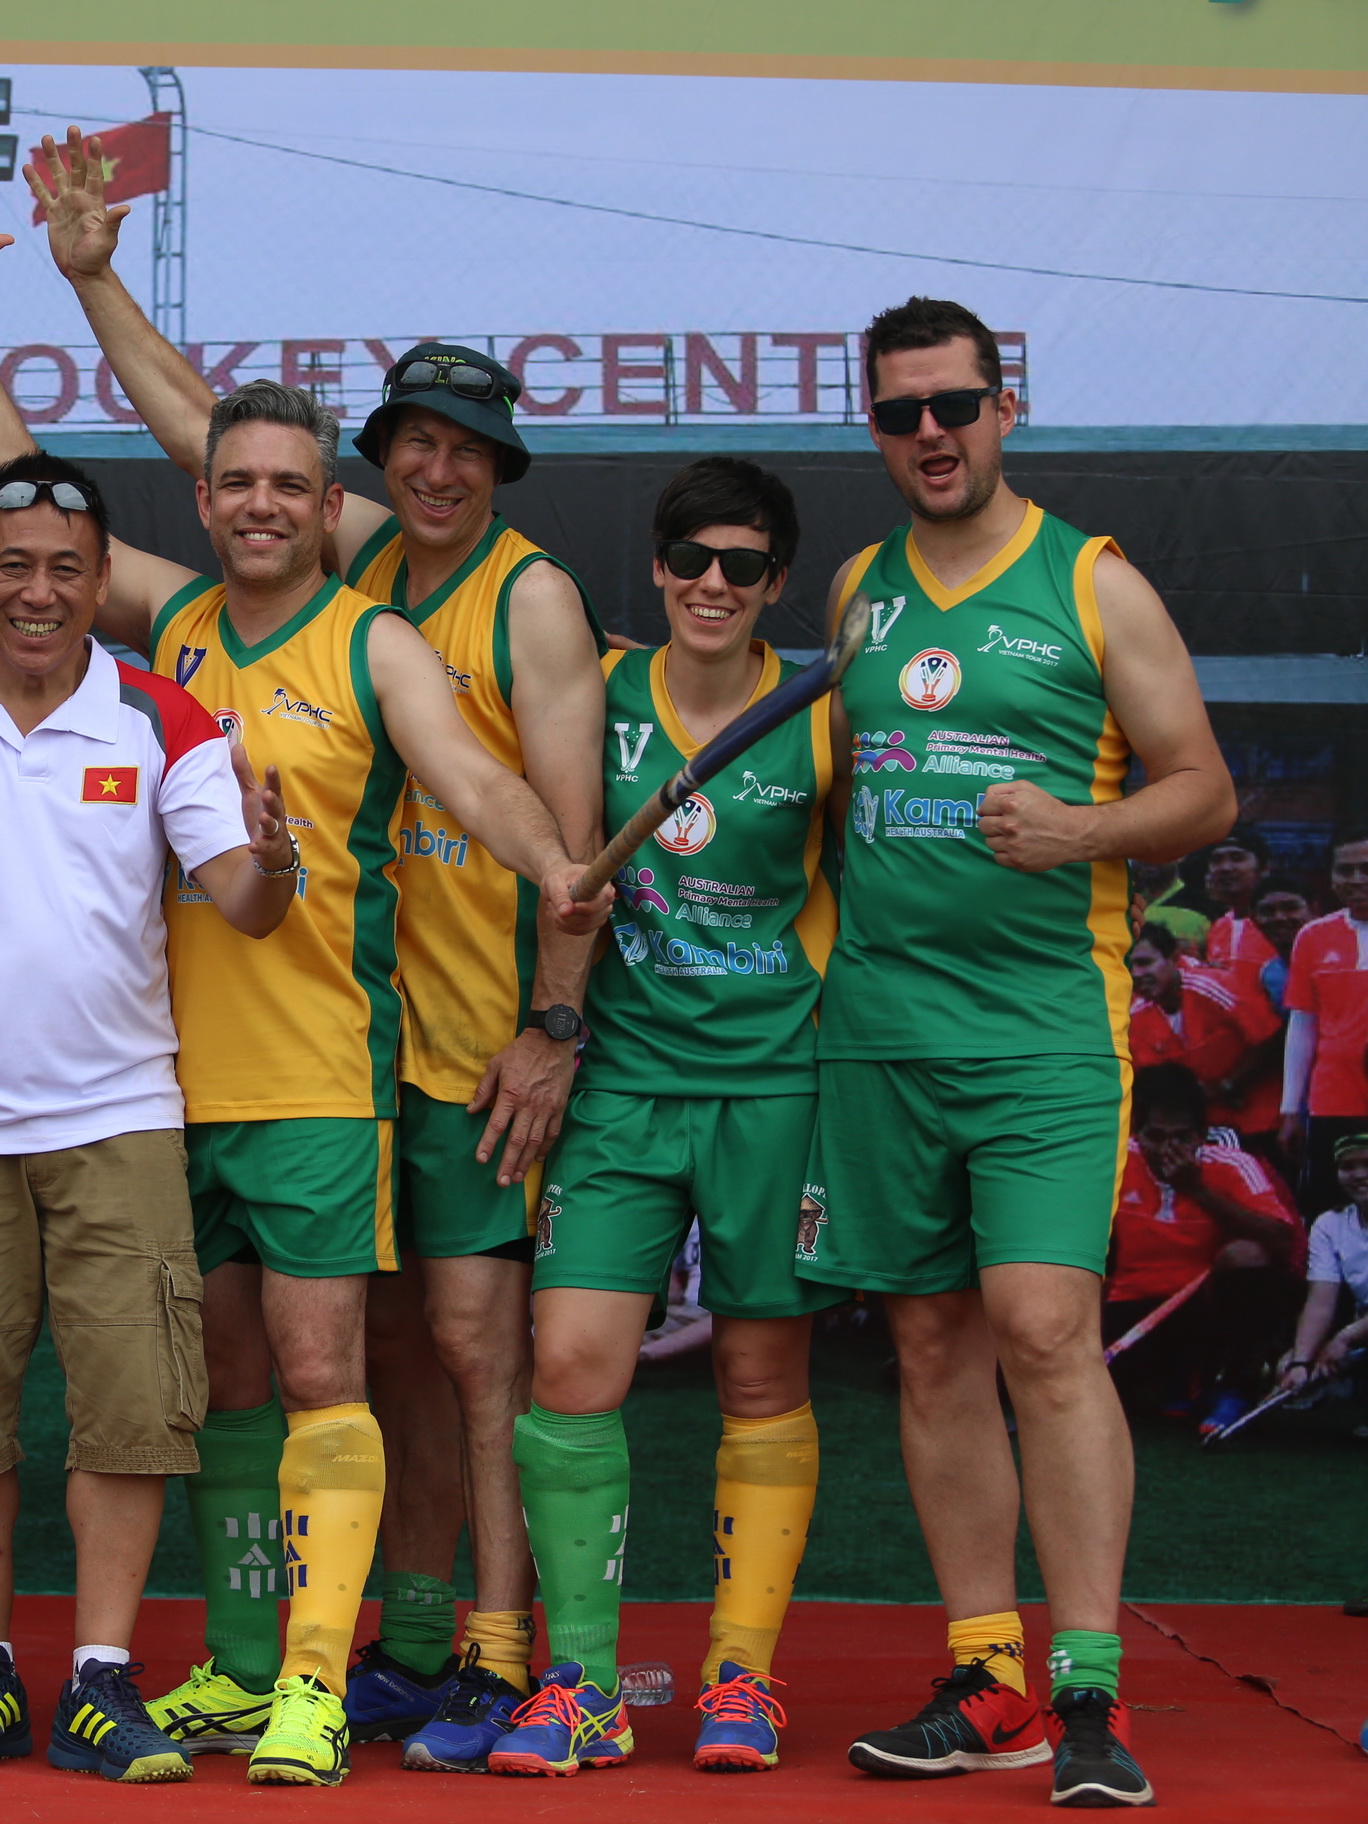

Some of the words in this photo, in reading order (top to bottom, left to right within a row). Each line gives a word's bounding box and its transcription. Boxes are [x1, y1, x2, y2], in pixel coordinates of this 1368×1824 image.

[509, 332, 1026, 416] CENTE
[864, 644, 888, 654] VPHC
[998, 649, 1025, 659] VIETNAM
[1025, 654, 1042, 663] TOUR
[1042, 658, 1059, 667] 2017
[1001, 635, 1063, 660] VPHC
[445, 664, 472, 688] PHC
[284, 699, 334, 723] VPHC
[927, 730, 1010, 746] AUSTRALIAN
[925, 742, 969, 755] Primary
[969, 745, 1009, 757] Mental
[1009, 749, 1047, 763] Health
[921, 754, 1016, 780] Alliance
[615, 774, 639, 783] VPHC
[756, 782, 808, 804] VPHC
[885, 826, 913, 837] HEALTH
[913, 826, 966, 840] AUSTRALIA
[678, 875, 756, 897] AUSTRALIAN
[677, 888, 719, 907] Primary
[718, 896, 751, 908] Mental
[675, 902, 753, 928] Alliance
[647, 929, 788, 975] Kambiri
[679, 964, 728, 977] AUSTRALIA
[802, 1254, 819, 1262] 2017
[374, 1671, 391, 1684] new
[389, 1680, 416, 1703] balance
